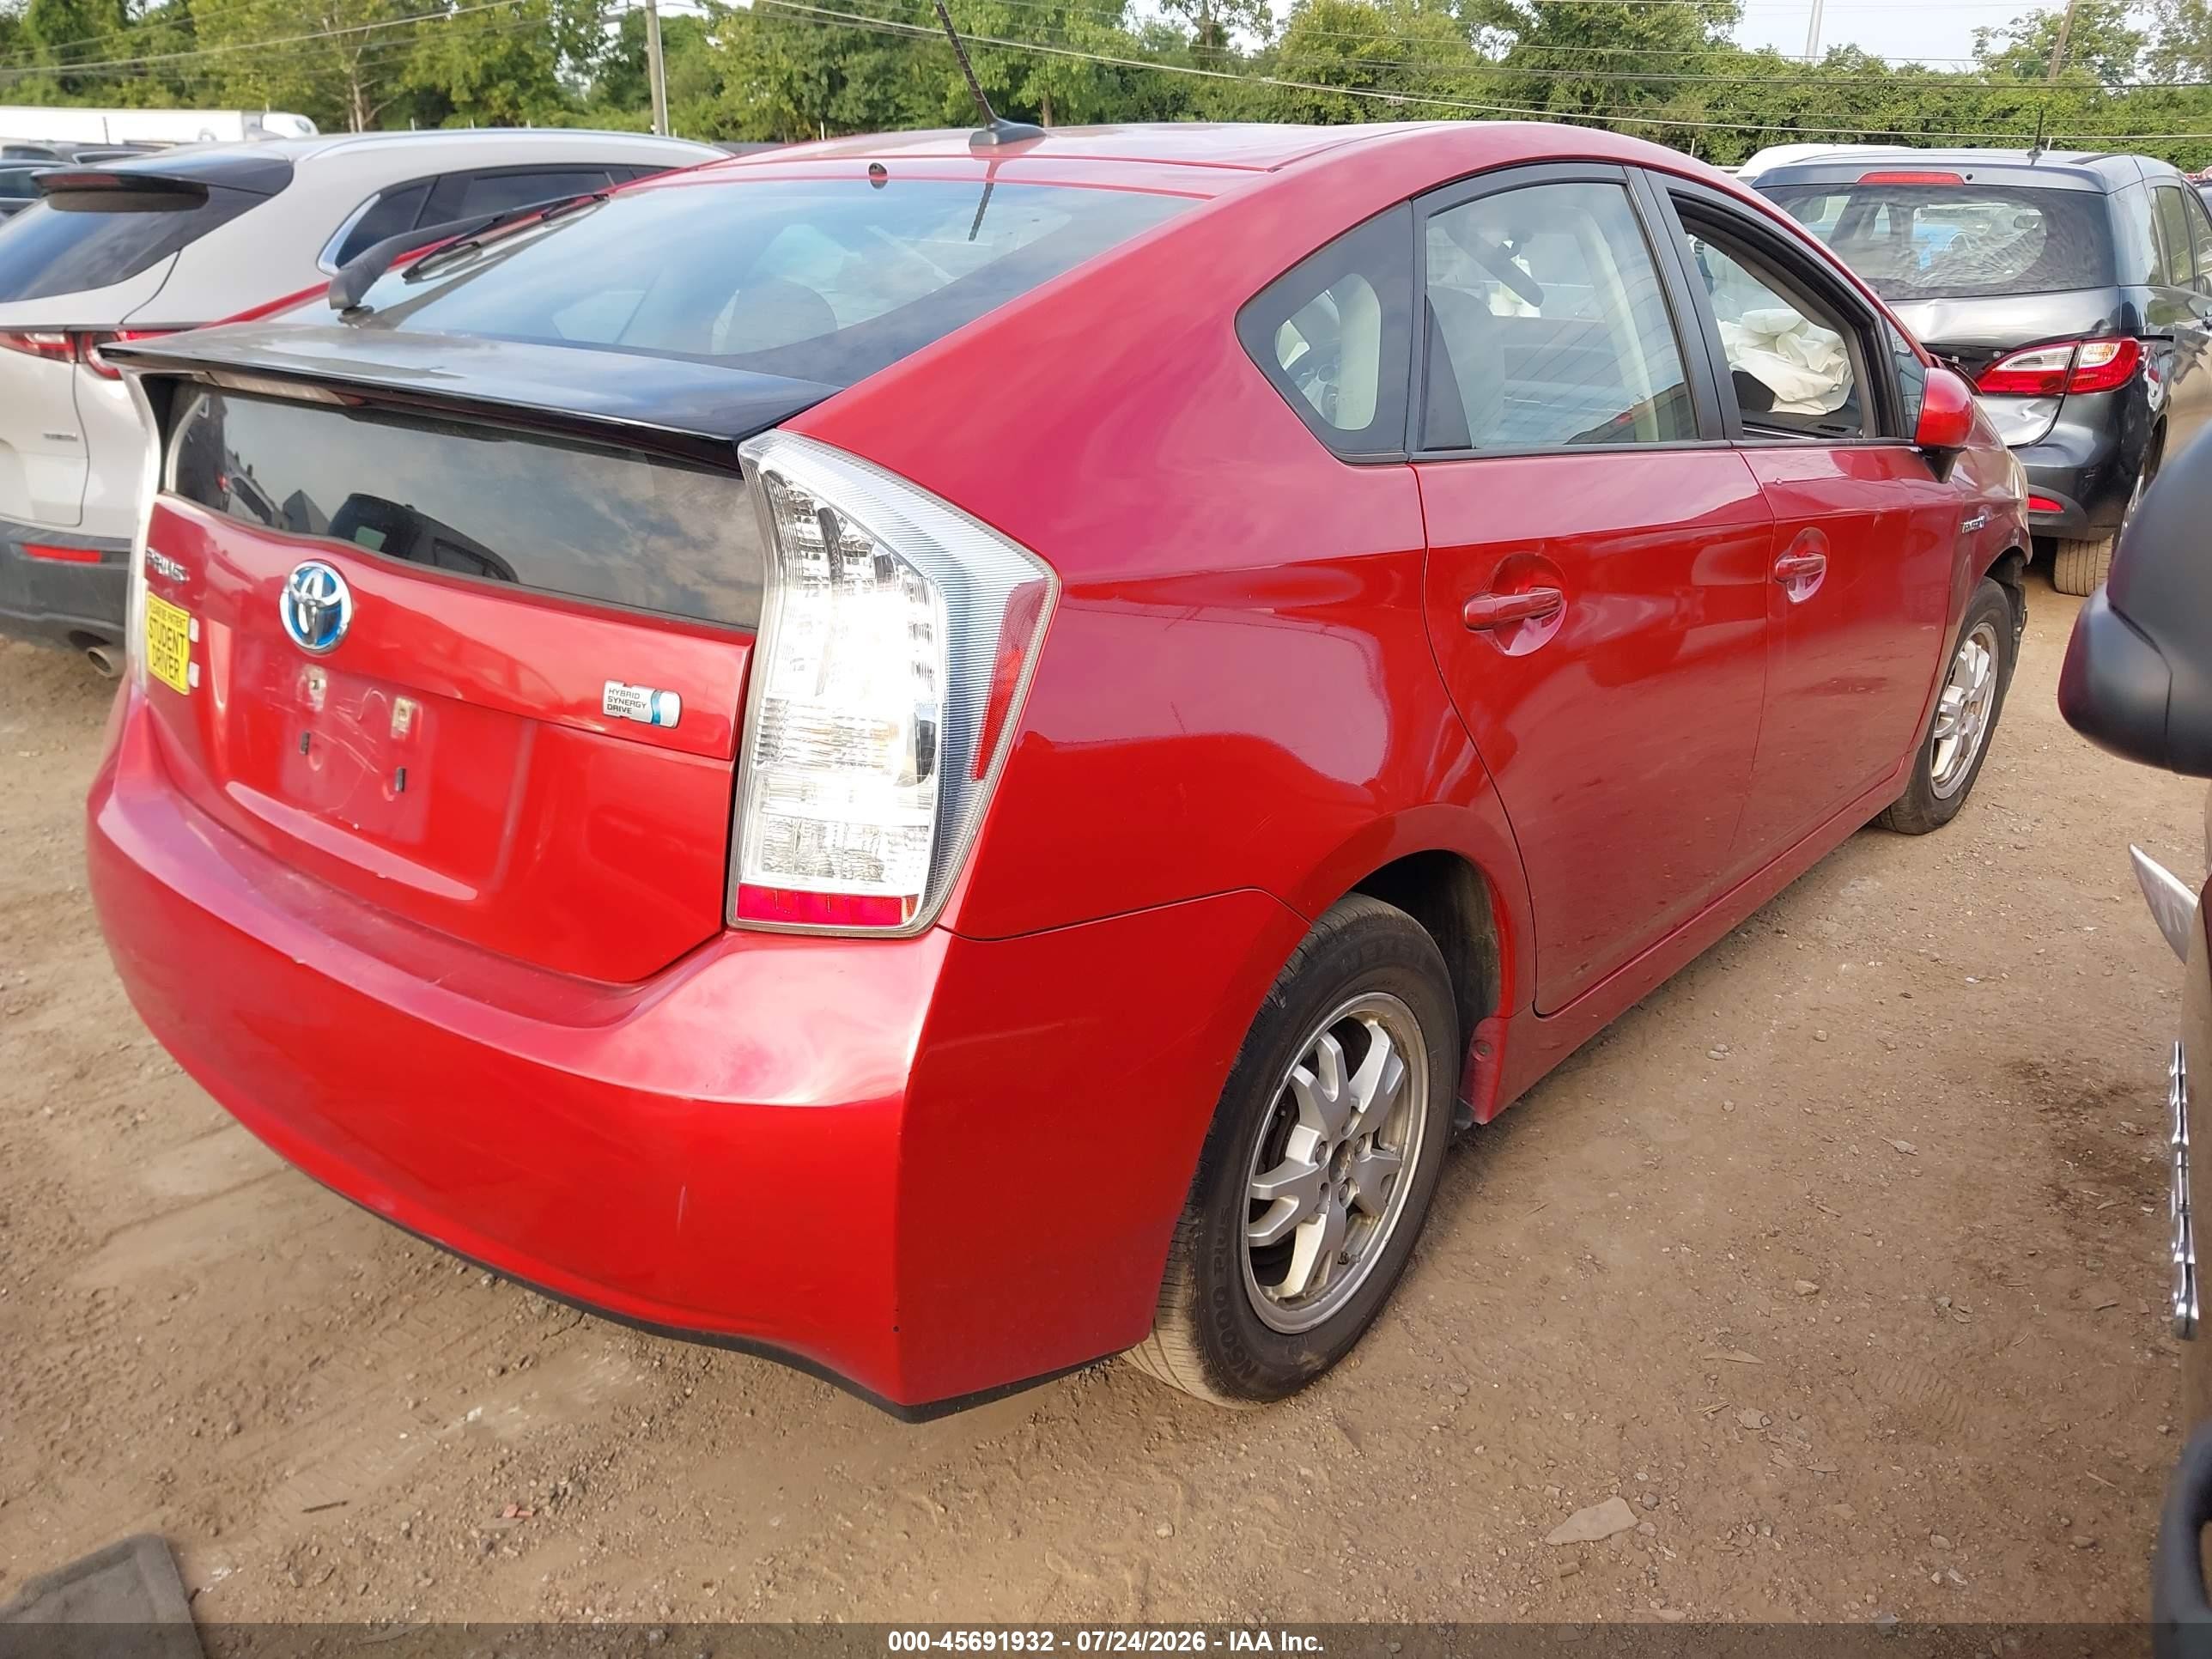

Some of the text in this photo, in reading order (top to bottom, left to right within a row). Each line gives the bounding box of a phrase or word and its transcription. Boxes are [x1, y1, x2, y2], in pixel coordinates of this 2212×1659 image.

[149, 617, 185, 658] STUDENT
[152, 644, 180, 683] DRIVER
[608, 688, 641, 700] HYBRID
[606, 703, 633, 714] DRIVE
[607, 696, 647, 709] SYNERGY
